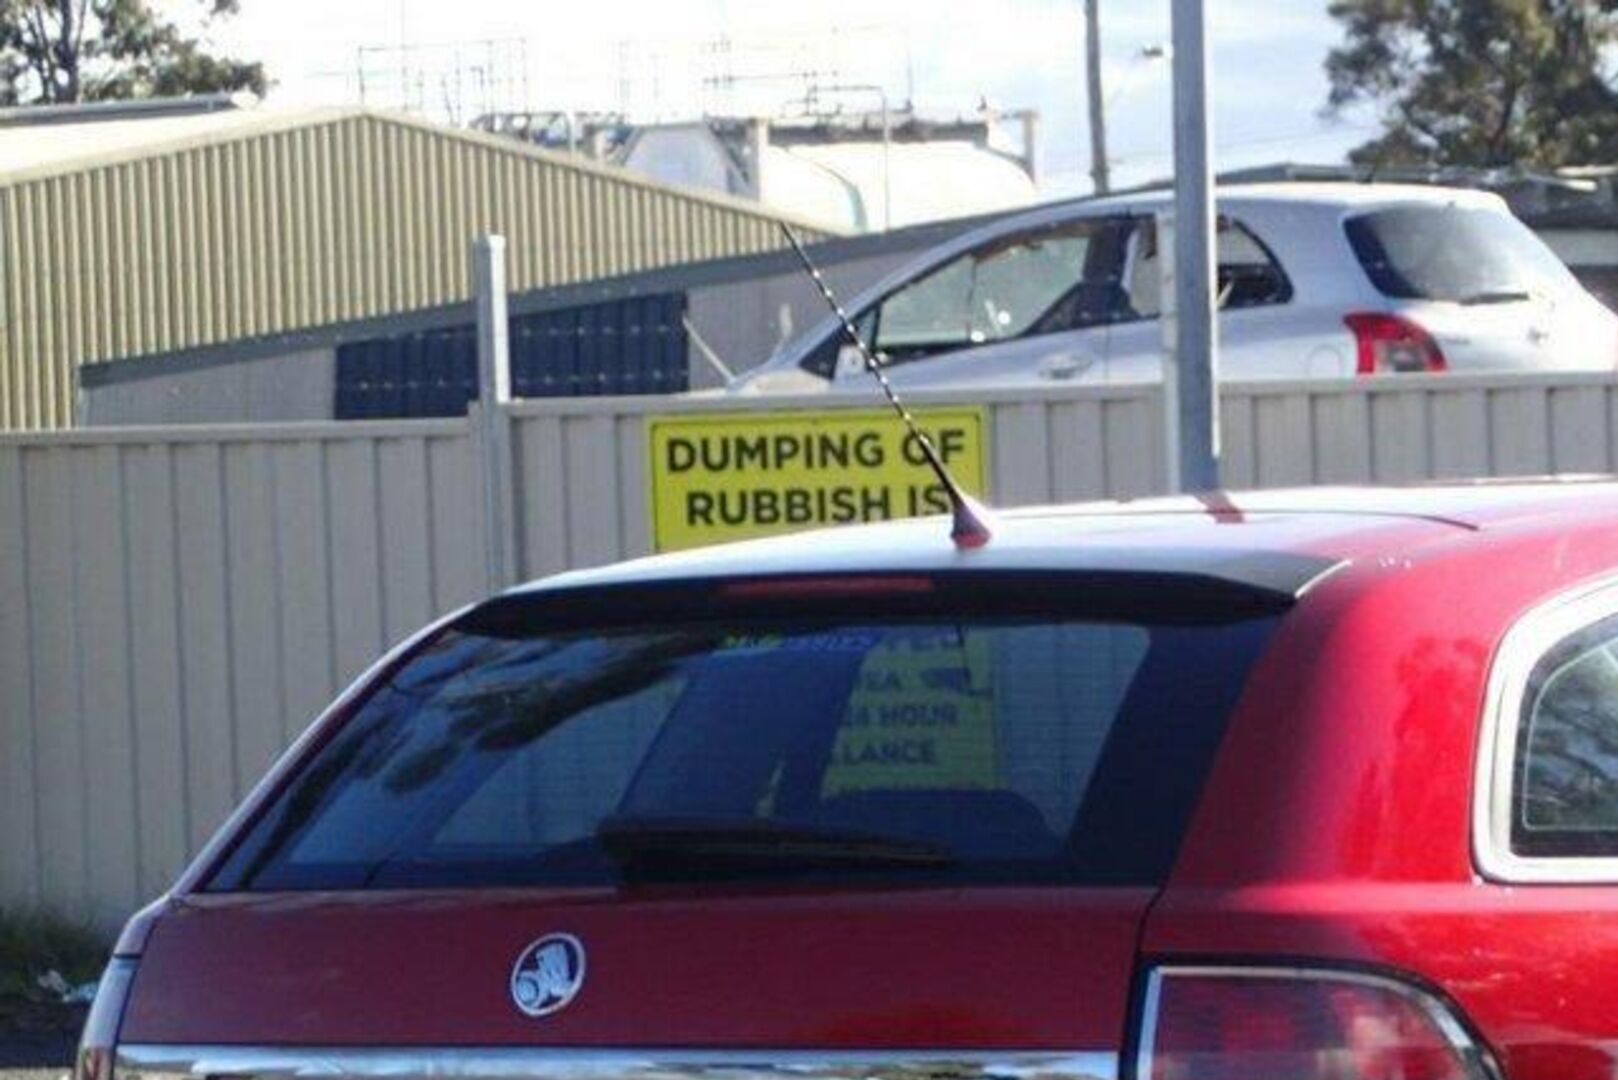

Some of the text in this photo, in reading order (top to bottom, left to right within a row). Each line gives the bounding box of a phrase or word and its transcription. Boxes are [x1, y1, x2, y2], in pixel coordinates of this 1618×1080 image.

[667, 429, 965, 473] DUMPING OF
[687, 484, 950, 526] RUBBISH IS
